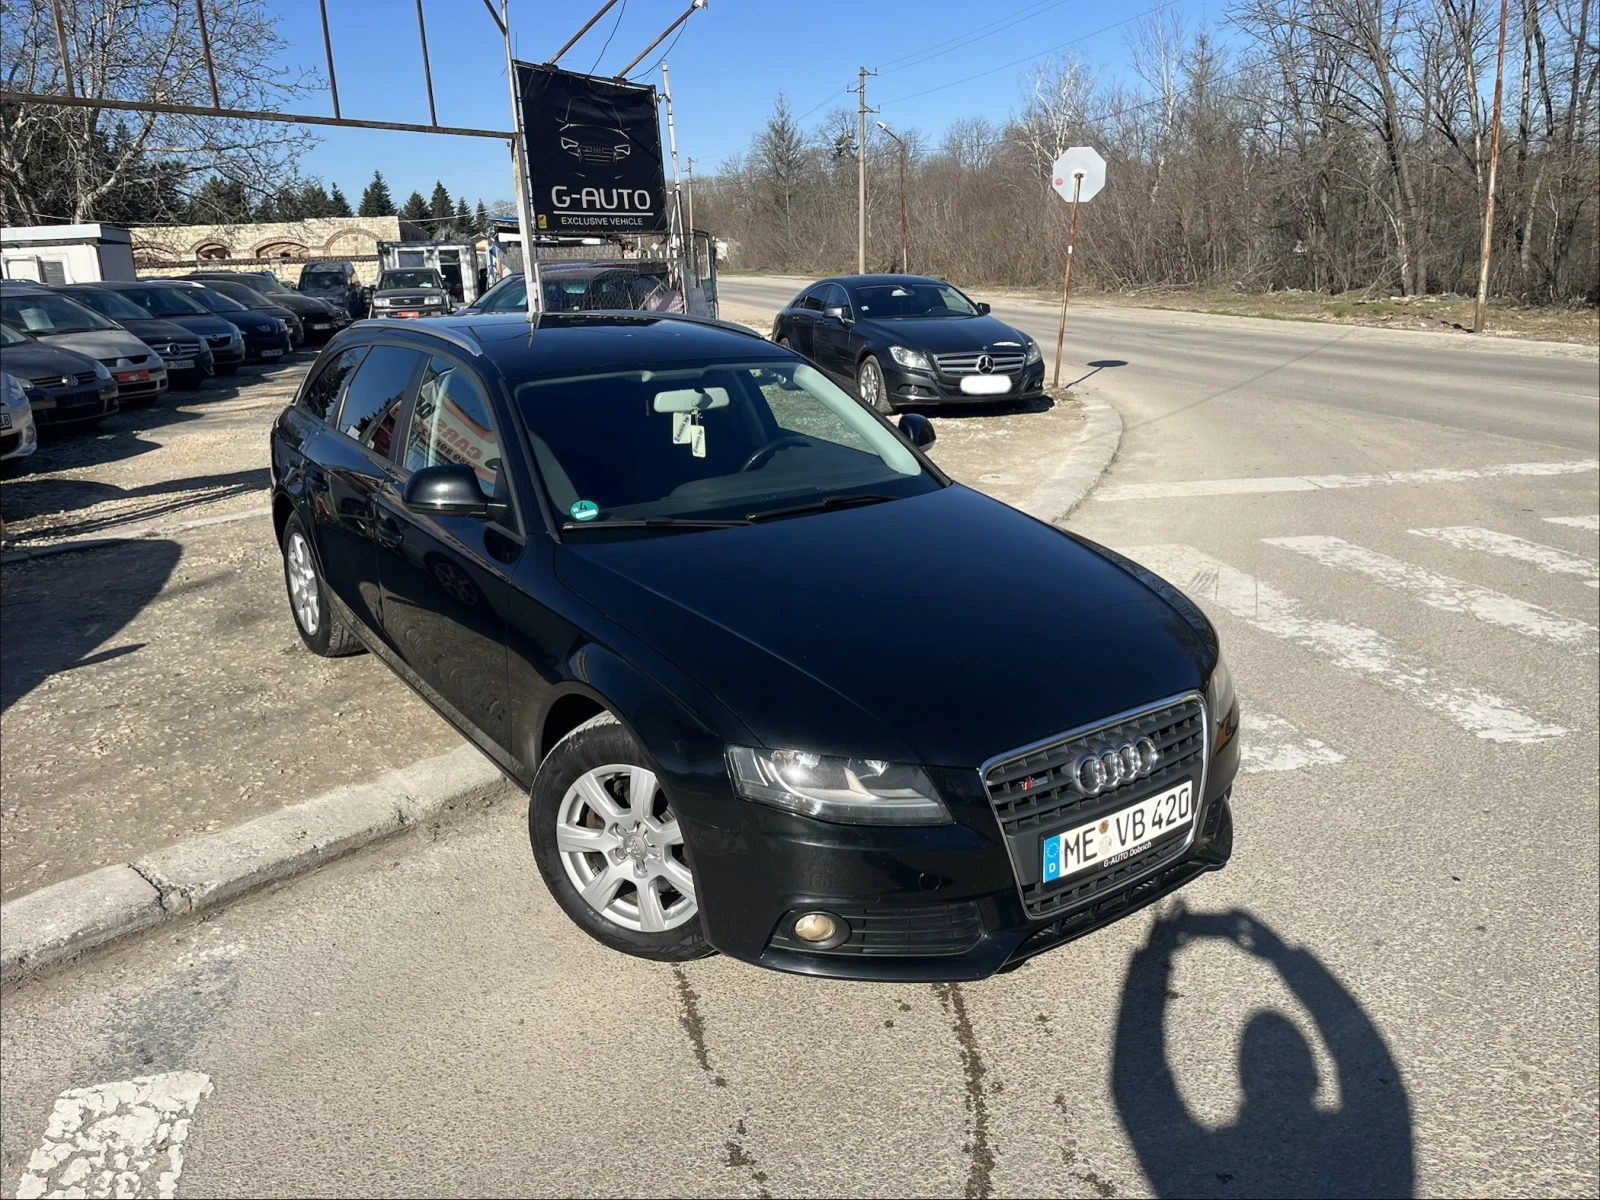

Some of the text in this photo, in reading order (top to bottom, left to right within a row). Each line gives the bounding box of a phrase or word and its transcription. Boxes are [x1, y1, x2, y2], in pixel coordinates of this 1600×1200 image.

[551, 185, 650, 210] G-AUTO
[561, 216, 643, 226] EXCLUSIVE VEHICLE
[579, 501, 588, 511] 4
[1048, 787, 1190, 874] D ME VB 420
[1103, 841, 1152, 868] G-AUTO Dobrich
